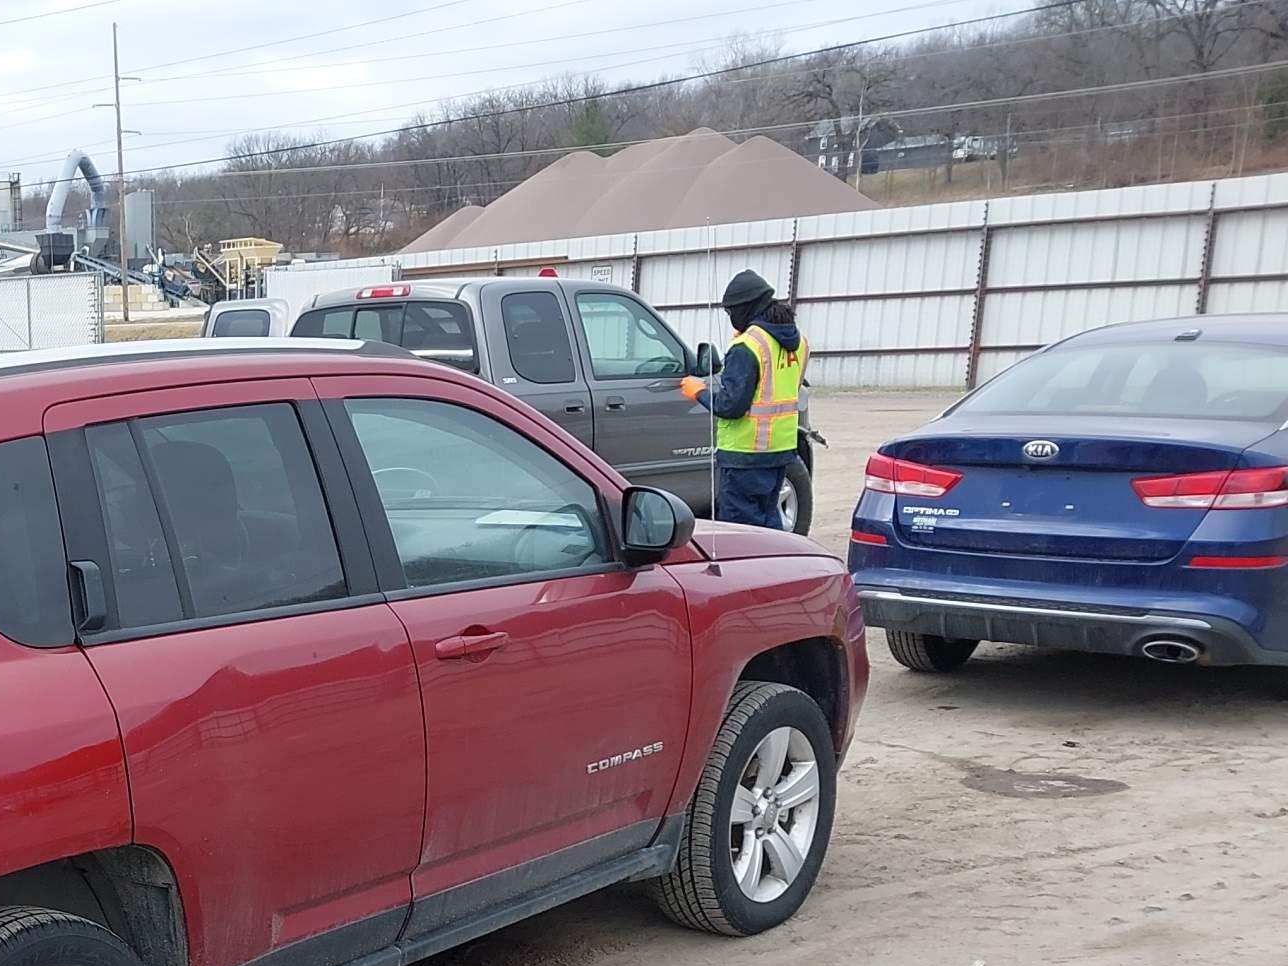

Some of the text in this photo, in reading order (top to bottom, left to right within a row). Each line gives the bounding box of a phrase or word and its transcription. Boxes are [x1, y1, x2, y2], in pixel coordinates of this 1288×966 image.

[1028, 444, 1052, 456] KIA
[903, 506, 945, 516] OPTIMA
[586, 741, 664, 774] COMPASS
